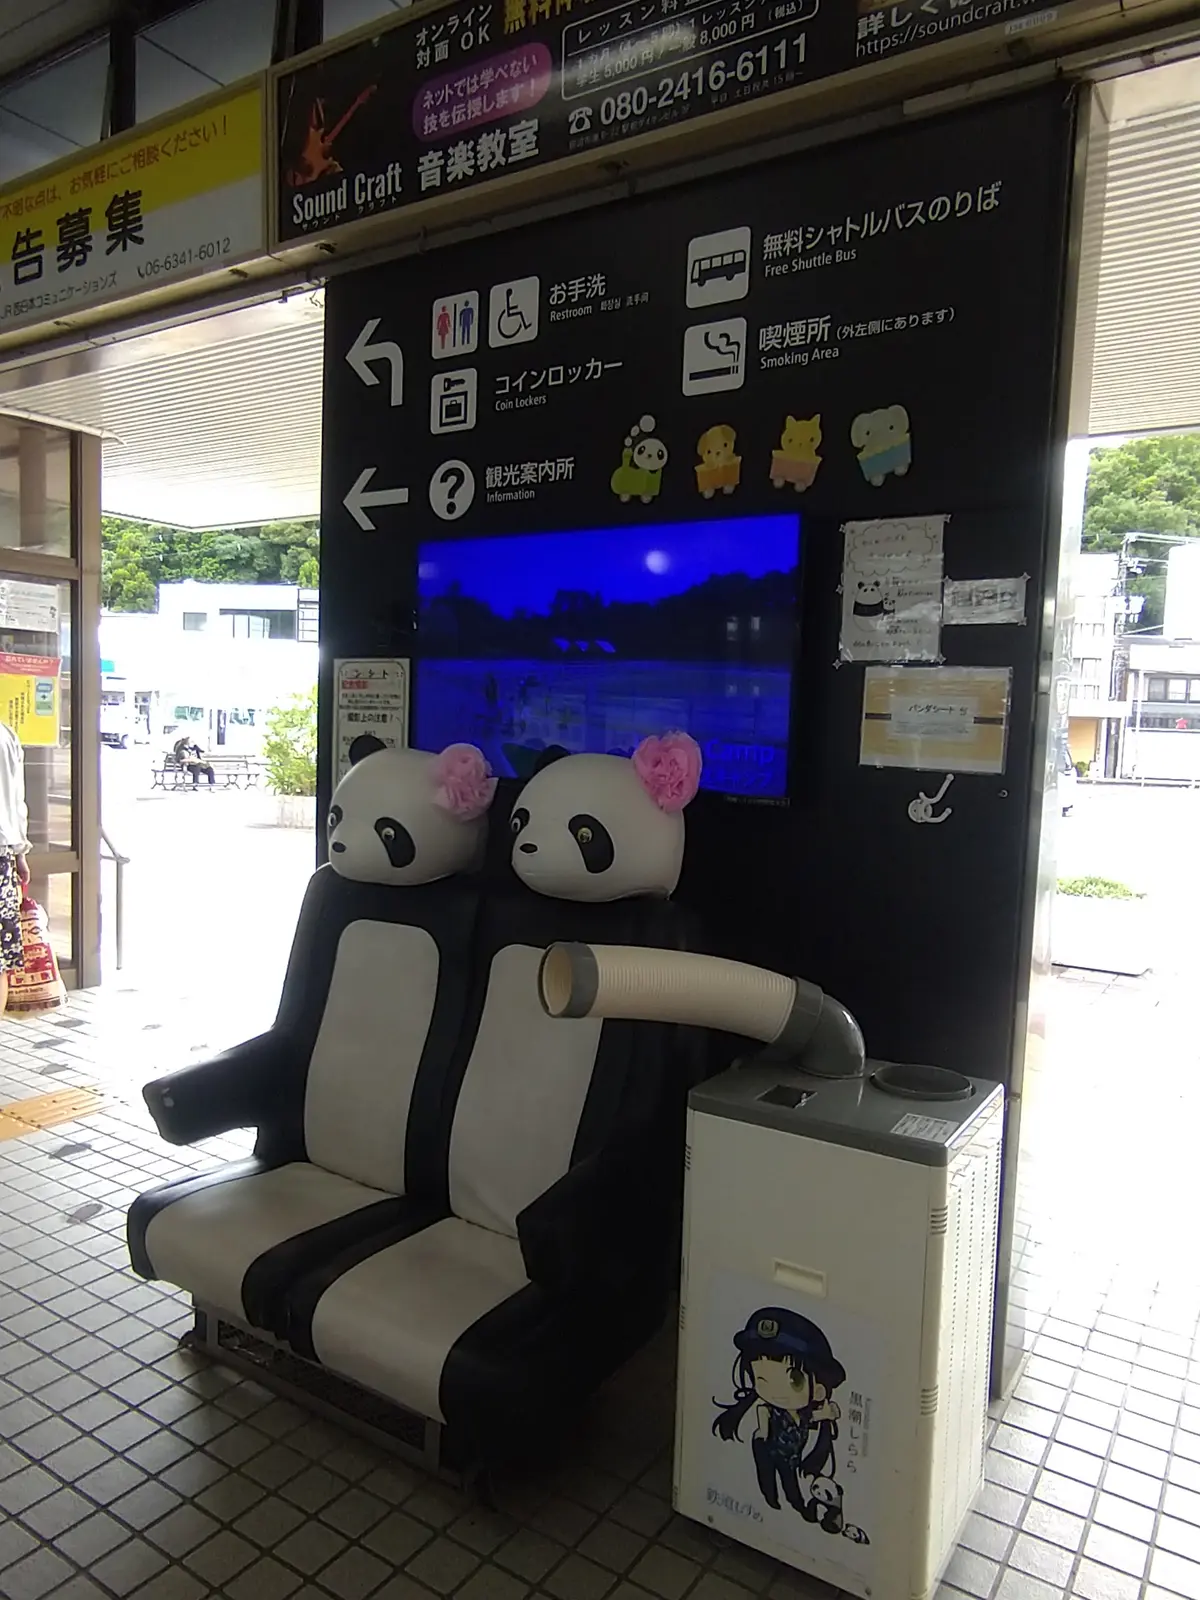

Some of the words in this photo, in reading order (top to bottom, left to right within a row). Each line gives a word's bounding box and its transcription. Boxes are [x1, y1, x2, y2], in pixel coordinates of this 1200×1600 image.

[415, 4, 492, 48] オンライン
[578, 0, 700, 45] レッスン料
[700, 12, 755, 46] 8,000円
[856, 0, 1037, 57] https://soundcraft.
[416, 39, 449, 69] 対面
[461, 23, 490, 51] OK
[422, 54, 538, 111] ネットでは学べない
[600, 32, 807, 126] 080-2416-6111
[422, 78, 536, 136] 技を伝授します！
[292, 179, 347, 225] Sound
[354, 161, 402, 206] Craft
[418, 118, 539, 191] 音楽教室
[357, 195, 398, 214] クラフト
[763, 181, 1002, 261] 無料シャトルバスのりば
[0, 189, 145, 291] 告募集
[145, 237, 231, 277] 06-6341-6012
[764, 261, 789, 278] Free
[791, 252, 832, 273] Shuttle
[835, 248, 857, 264] Bus
[549, 273, 606, 305] お手洗
[550, 305, 592, 322] Restroom
[758, 314, 831, 351] 喫煙所
[836, 306, 956, 341] （外左側にあります）
[495, 358, 623, 395] コインロッカー
[760, 351, 809, 370] Smoking
[811, 347, 839, 361] Area
[495, 399, 514, 412] Coin
[515, 394, 547, 409] Lockers
[485, 456, 575, 489] 観光案内所
[487, 488, 535, 503] Information
